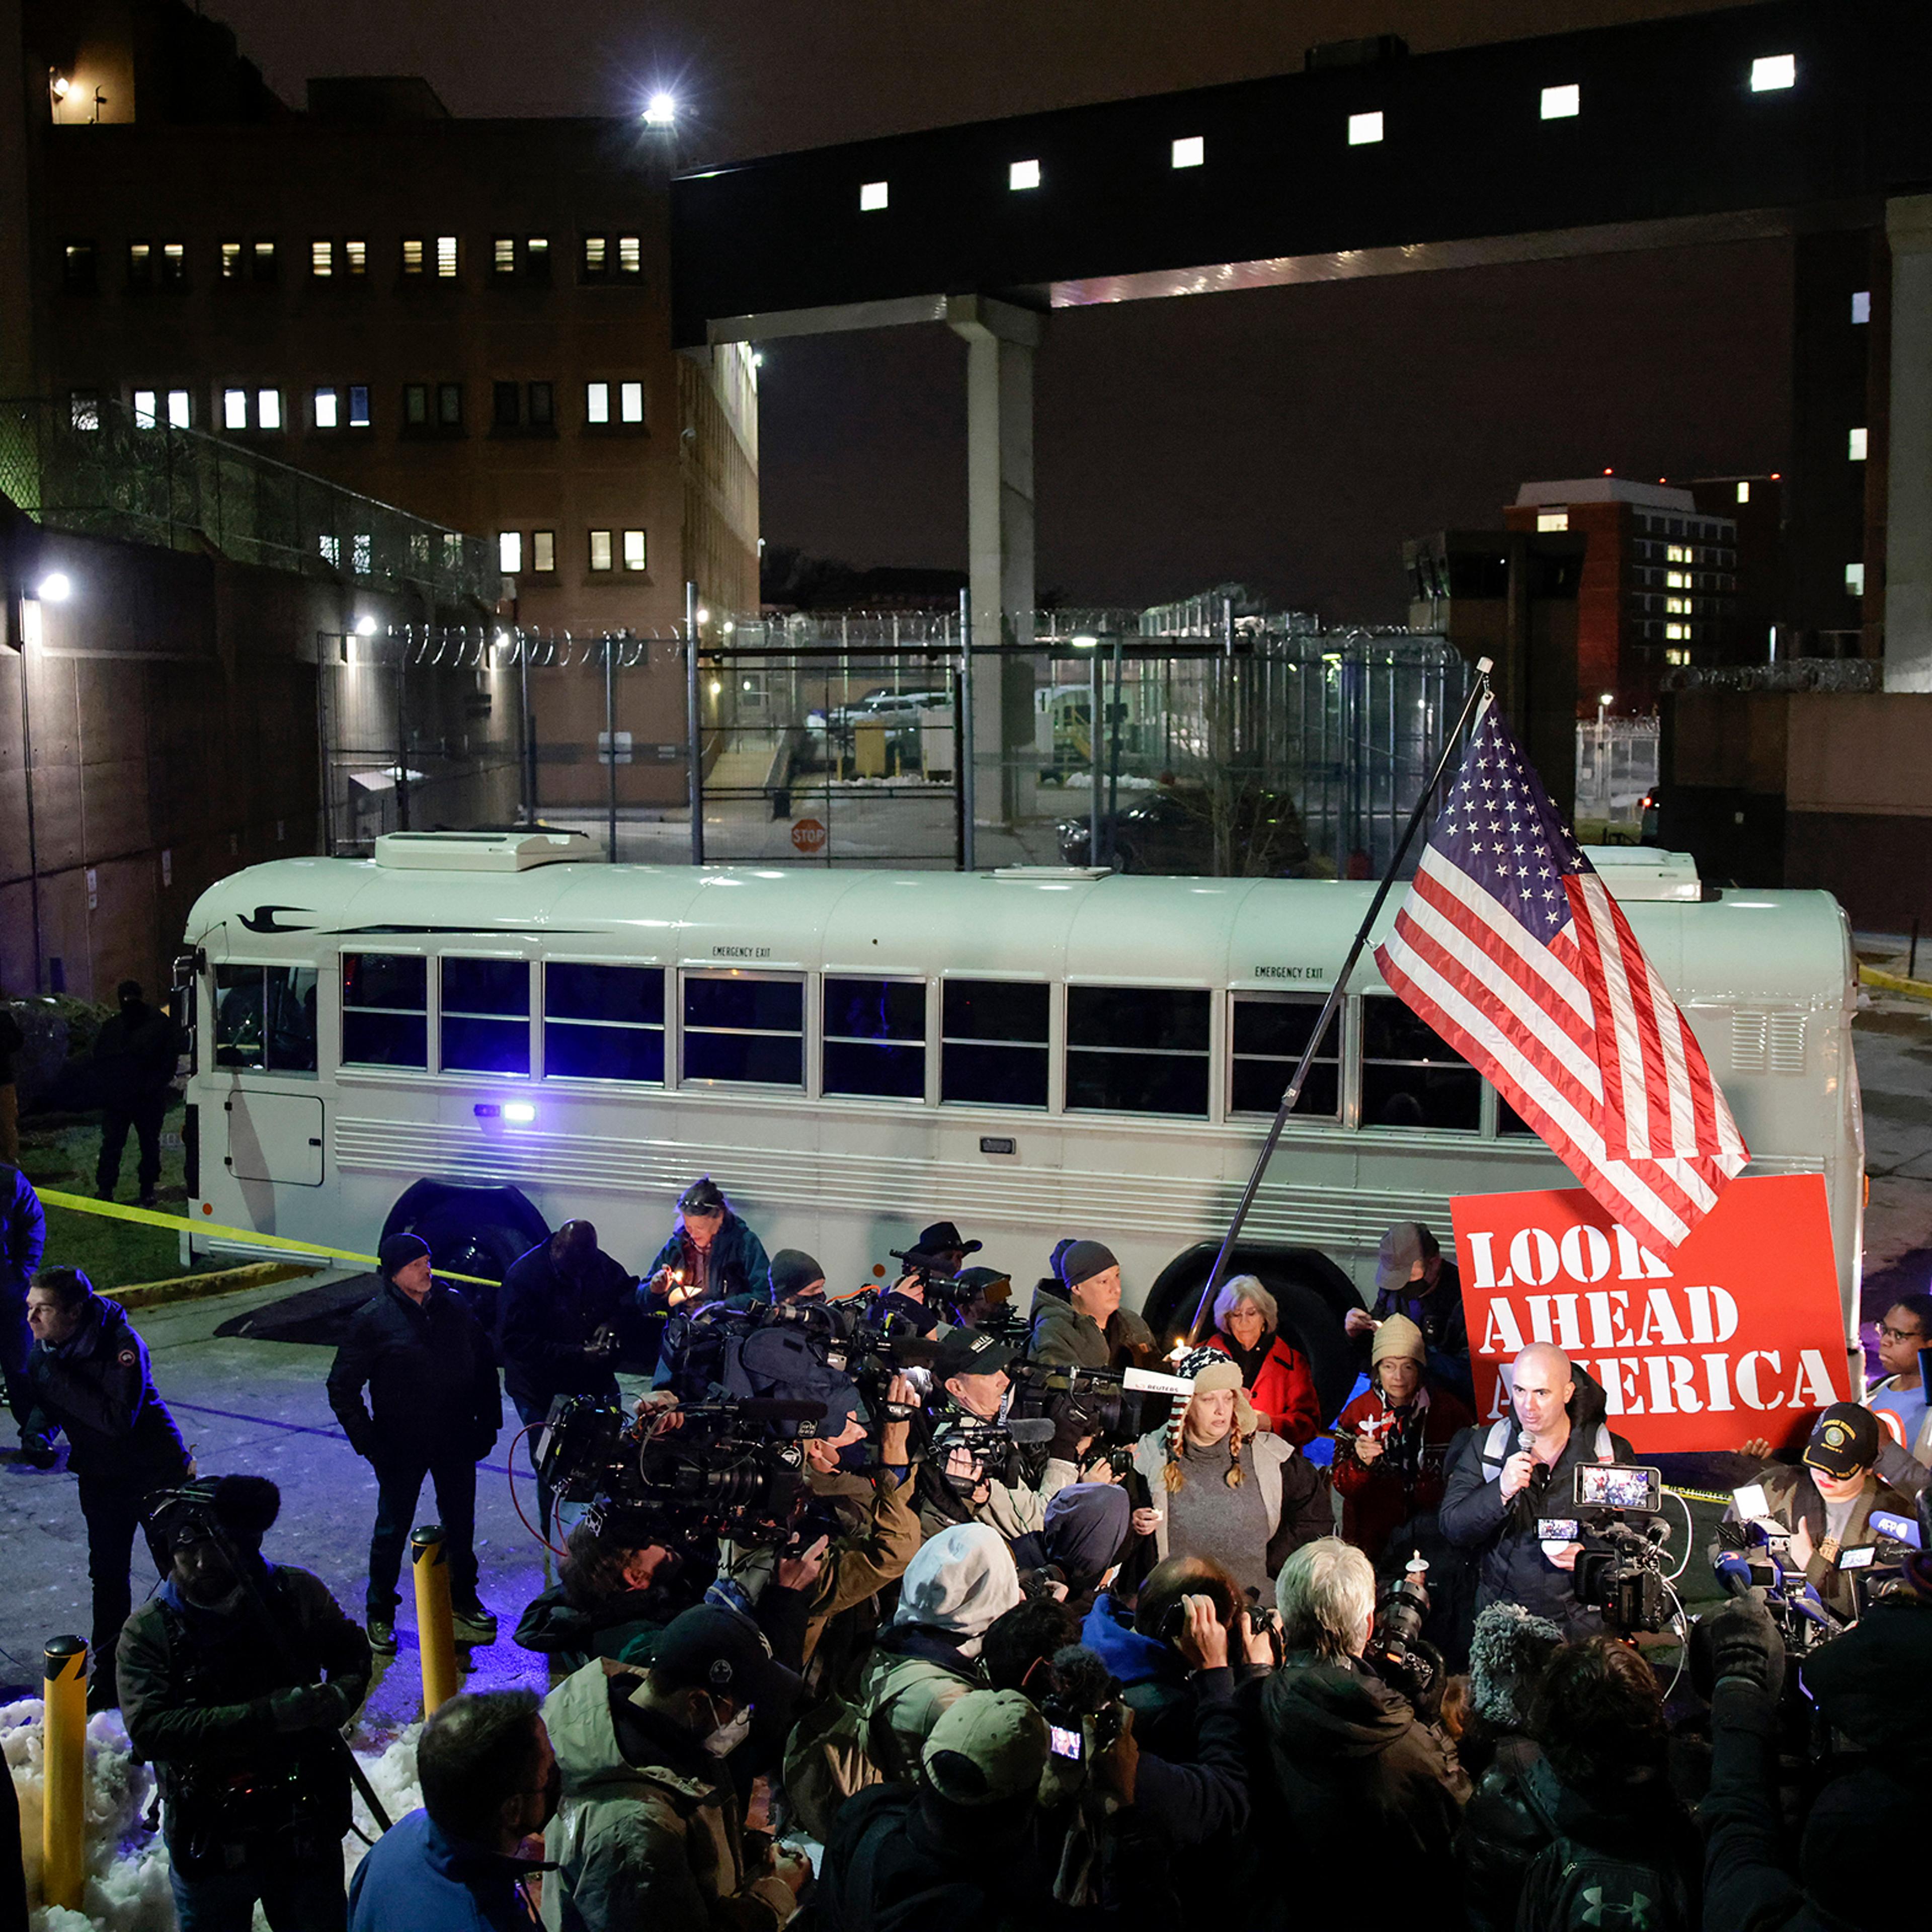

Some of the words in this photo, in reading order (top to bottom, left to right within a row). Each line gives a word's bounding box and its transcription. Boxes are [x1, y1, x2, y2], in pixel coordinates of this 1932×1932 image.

[793, 829, 825, 843] STOP
[712, 946, 753, 957] EMERGENCY
[756, 947, 770, 957] EXIT
[1255, 966, 1303, 978] EMERGENCY
[1306, 968, 1323, 979] EXIT
[1479, 1285, 1739, 1353] AHEAD
[1487, 1349, 1839, 1419] AERICA
[1878, 1518, 1897, 1532] AFP
